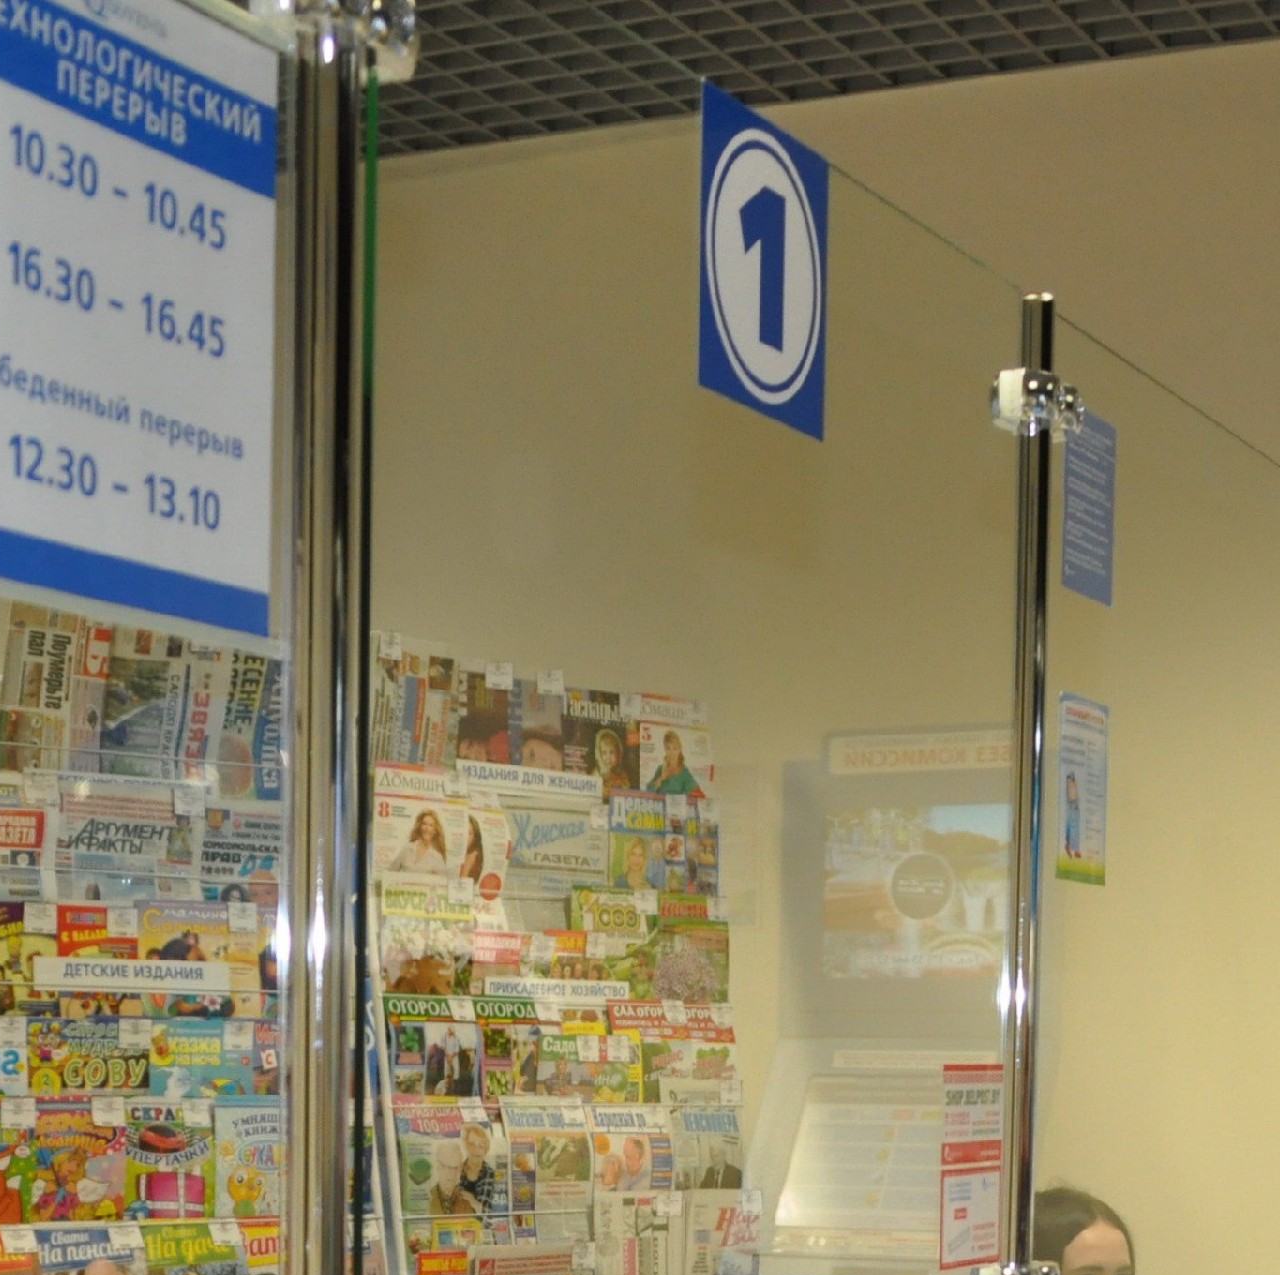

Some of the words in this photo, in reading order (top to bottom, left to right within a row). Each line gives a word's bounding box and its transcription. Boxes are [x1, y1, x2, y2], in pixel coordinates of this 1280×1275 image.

[56, 59, 187, 146] ПЕРЕРЫВ
[9, 124, 99, 198] 10.30
[143, 183, 227, 250] 10.45
[738, 184, 786, 353] 1
[8, 241, 95, 311] 16.30
[140, 294, 226, 359] 16.45
[139, 406, 245, 460] перерыв
[9, 434, 98, 498] 12.30
[143, 475, 221, 531] 13.10
[233, 654, 266, 735] ЕСЕННЕ-
[378, 770, 446, 793] Домашн
[462, 764, 520, 782] ИЗДАНИЯ
[522, 769, 545, 785] ДЛЯ
[548, 773, 598, 792] ЖЕНЩИН
[79, 818, 174, 842] АРГУМЕНТ
[533, 852, 591, 867] ГАЗЕТА
[63, 963, 129, 979] ДЕТСКИЕ
[133, 965, 204, 980] ИЗДАНИЯ
[489, 981, 567, 997] ПРИУСАДЕБНОЕ
[571, 983, 627, 998] ХОЗЯЙСТВО
[63, 1056, 148, 1088] СОВУ
[231, 1113, 280, 1129] УМНЯШ
[243, 1125, 280, 1137] КНИЖ
[125, 1140, 211, 1166] УПЕРТАЧКИ
[39, 1244, 64, 1265] На
[145, 1234, 177, 1261] На
